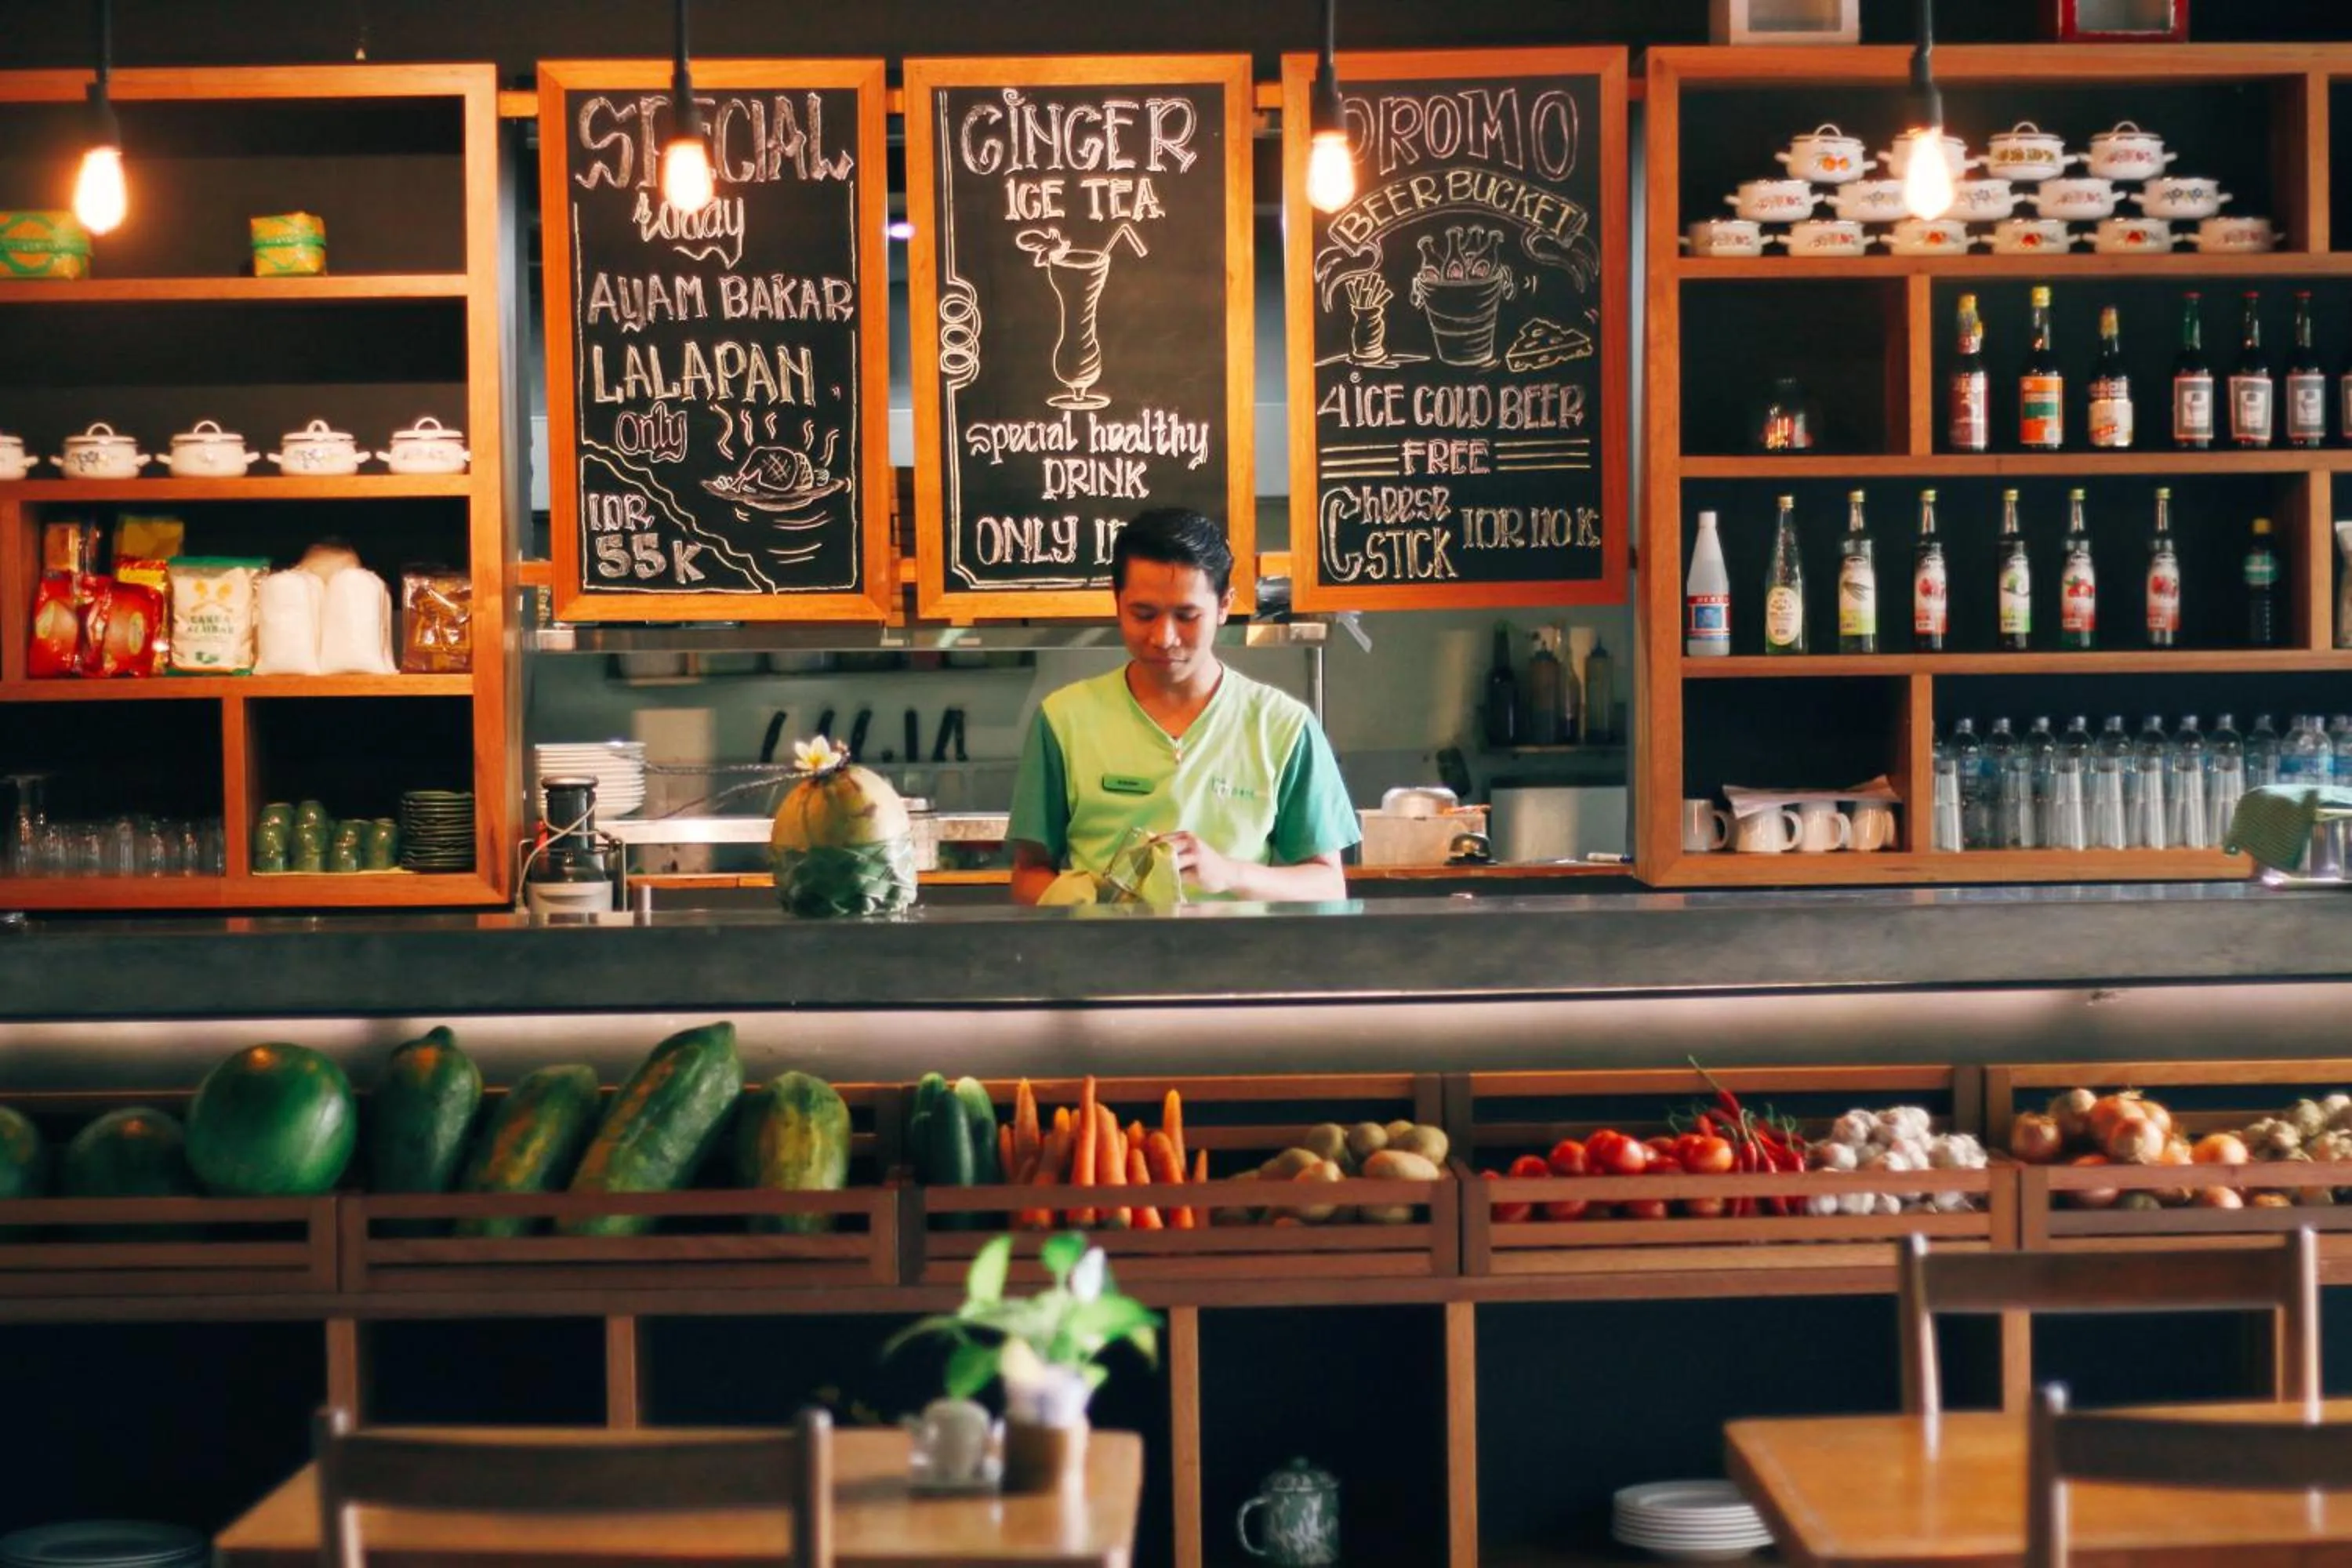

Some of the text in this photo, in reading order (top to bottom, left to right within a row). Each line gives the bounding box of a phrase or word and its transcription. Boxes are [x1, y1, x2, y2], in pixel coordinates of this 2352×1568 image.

[575, 93, 855, 190] SPCIAL
[1004, 177, 1166, 222] ICE TEA
[1338, 171, 1577, 242] BEER BUCKET
[587, 272, 853, 332] AYAM BAKAR
[593, 341, 815, 407] LALAPAN
[1498, 383, 1584, 430] BEER
[965, 408, 1210, 470] special healthy
[1401, 437, 1491, 476] FREE
[1041, 457, 1150, 501] DRINK
[588, 492, 655, 532] IDR
[1459, 506, 1526, 550] IDR
[976, 516, 1079, 565] ONLY
